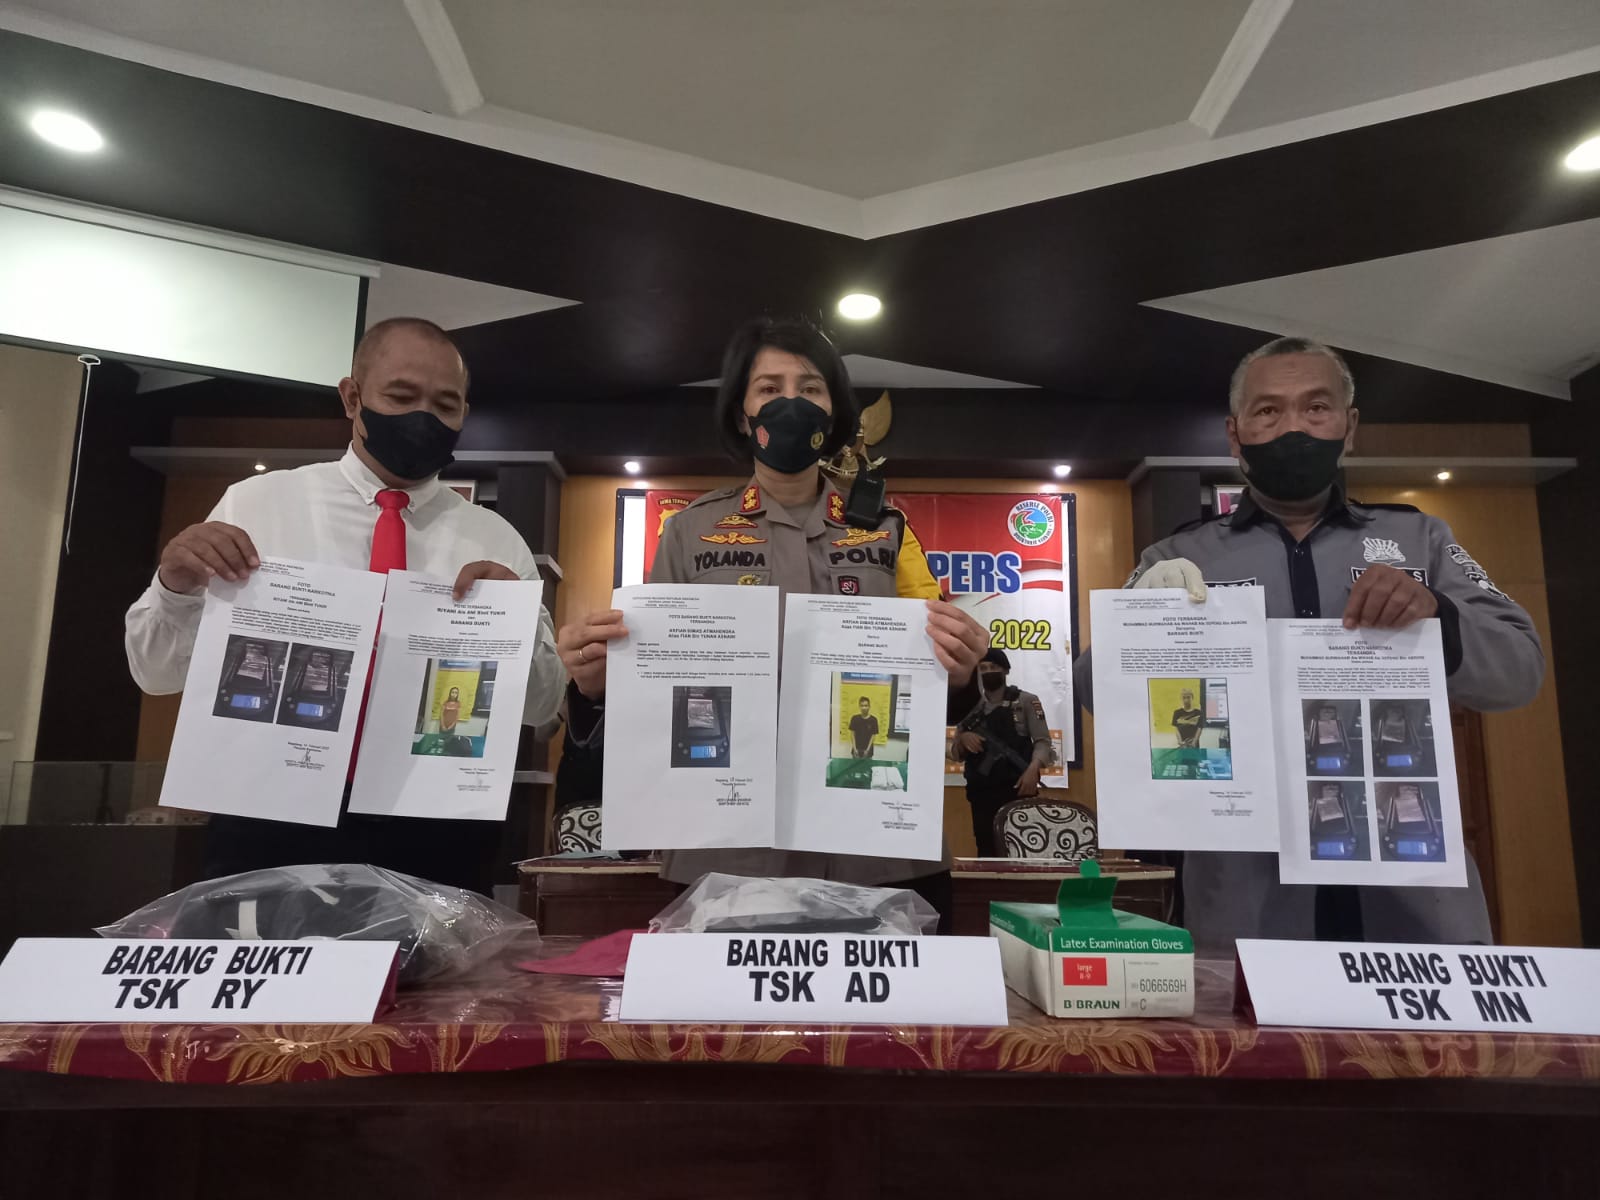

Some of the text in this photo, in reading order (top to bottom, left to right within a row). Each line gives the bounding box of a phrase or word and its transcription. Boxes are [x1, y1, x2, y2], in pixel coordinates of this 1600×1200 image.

[694, 550, 767, 571] YOLANDA
[829, 547, 896, 570] POLRI
[926, 551, 1022, 594] PERS
[990, 619, 1051, 650] 2022
[726, 939, 919, 967] BARANG BUKTI
[1060, 937, 1184, 950] Latex Examination Gloves
[102, 945, 313, 975] BARANG BUKTI
[1339, 952, 1547, 987] BARANG BUKTI
[114, 978, 267, 1009] TSK RY
[749, 971, 890, 1003] TSK AD
[1140, 979, 1187, 992] 6066569H
[1076, 1000, 1120, 1010] BRAUN
[1376, 988, 1533, 1023] TSK MN
